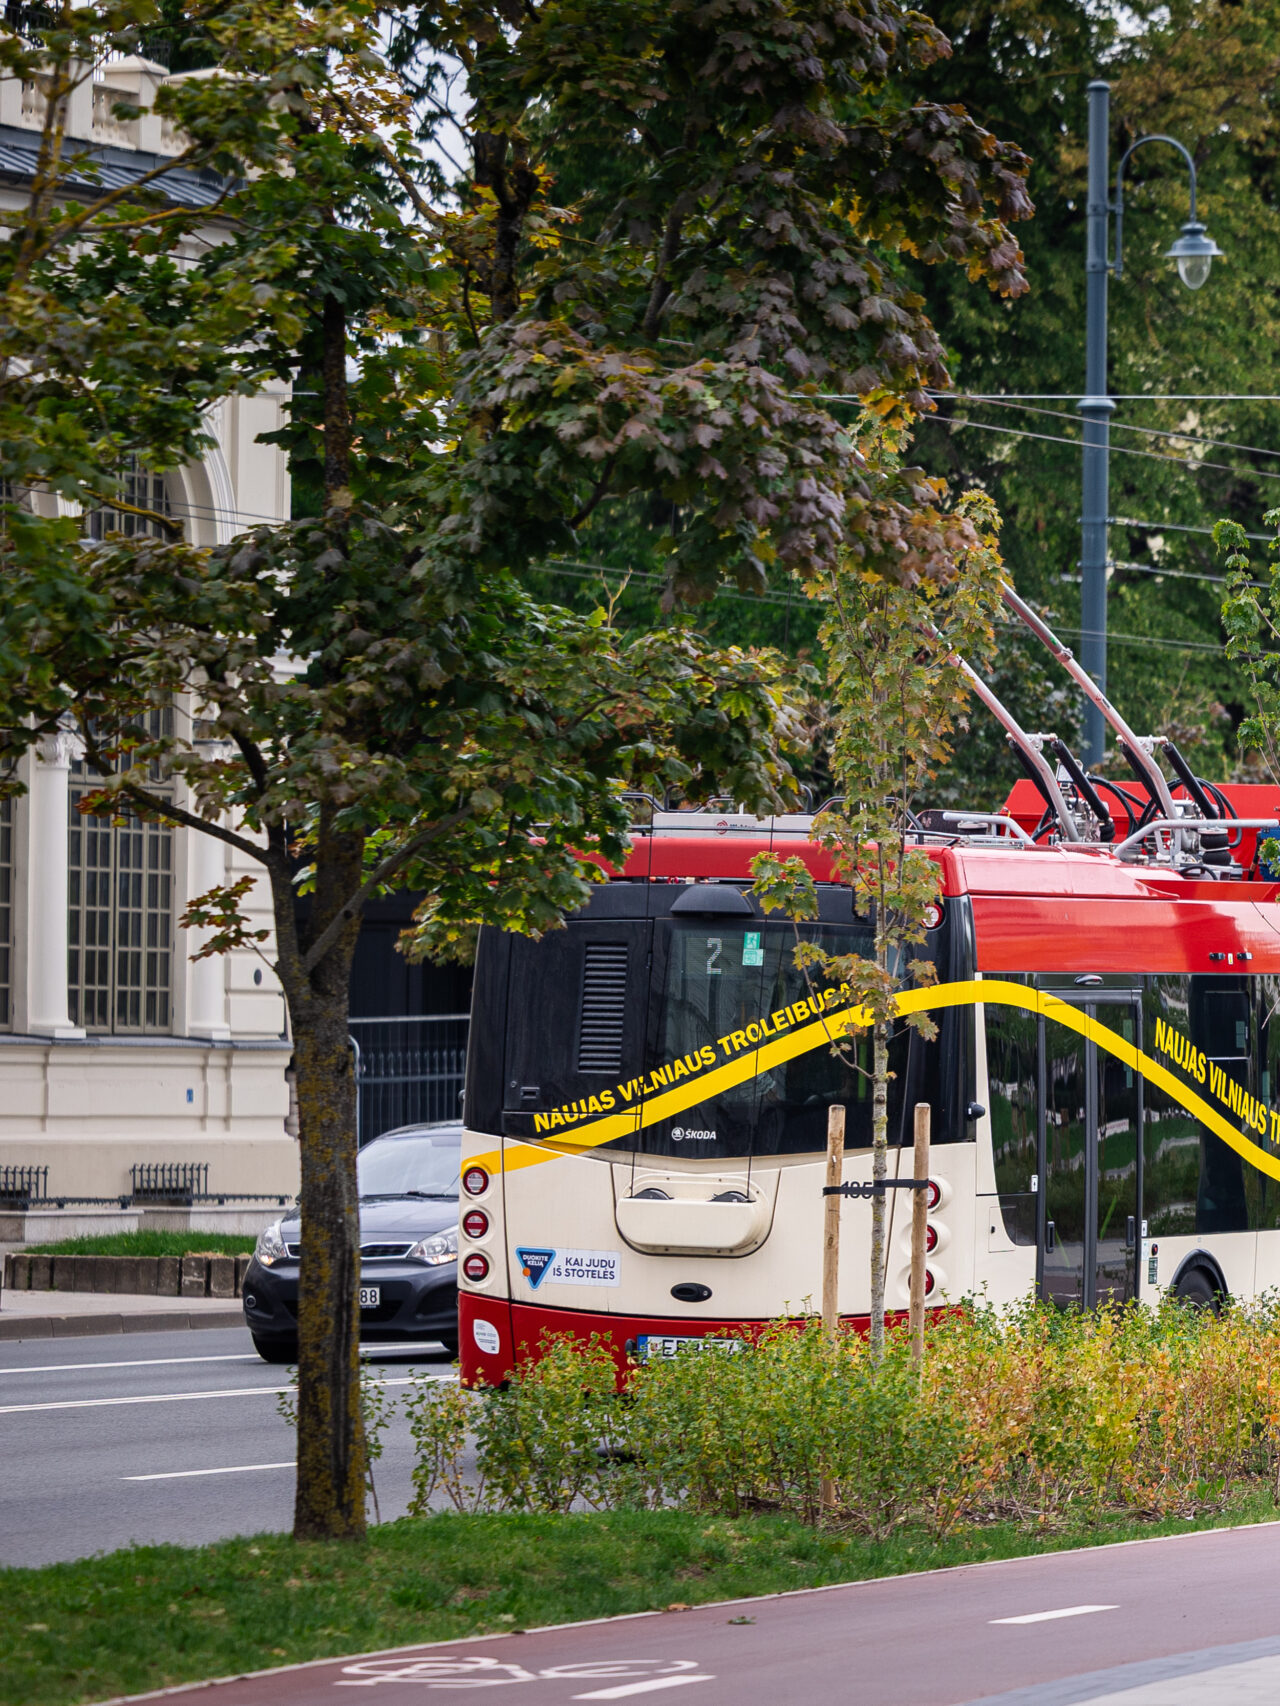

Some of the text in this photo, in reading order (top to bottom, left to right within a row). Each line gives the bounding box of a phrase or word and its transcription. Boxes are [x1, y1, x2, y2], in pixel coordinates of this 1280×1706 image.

[706, 937, 722, 974] 2
[533, 982, 868, 1133] NAUJAS VILNIAUS TROLEIBUSA
[1155, 1017, 1207, 1084] NAUJAS
[1209, 1061, 1267, 1134] VILNIAUS
[684, 1128, 717, 1140] ŠKODA
[552, 1265, 615, 1280] IŠ STOTELĖS
[565, 1257, 616, 1269] KAI JUDU
